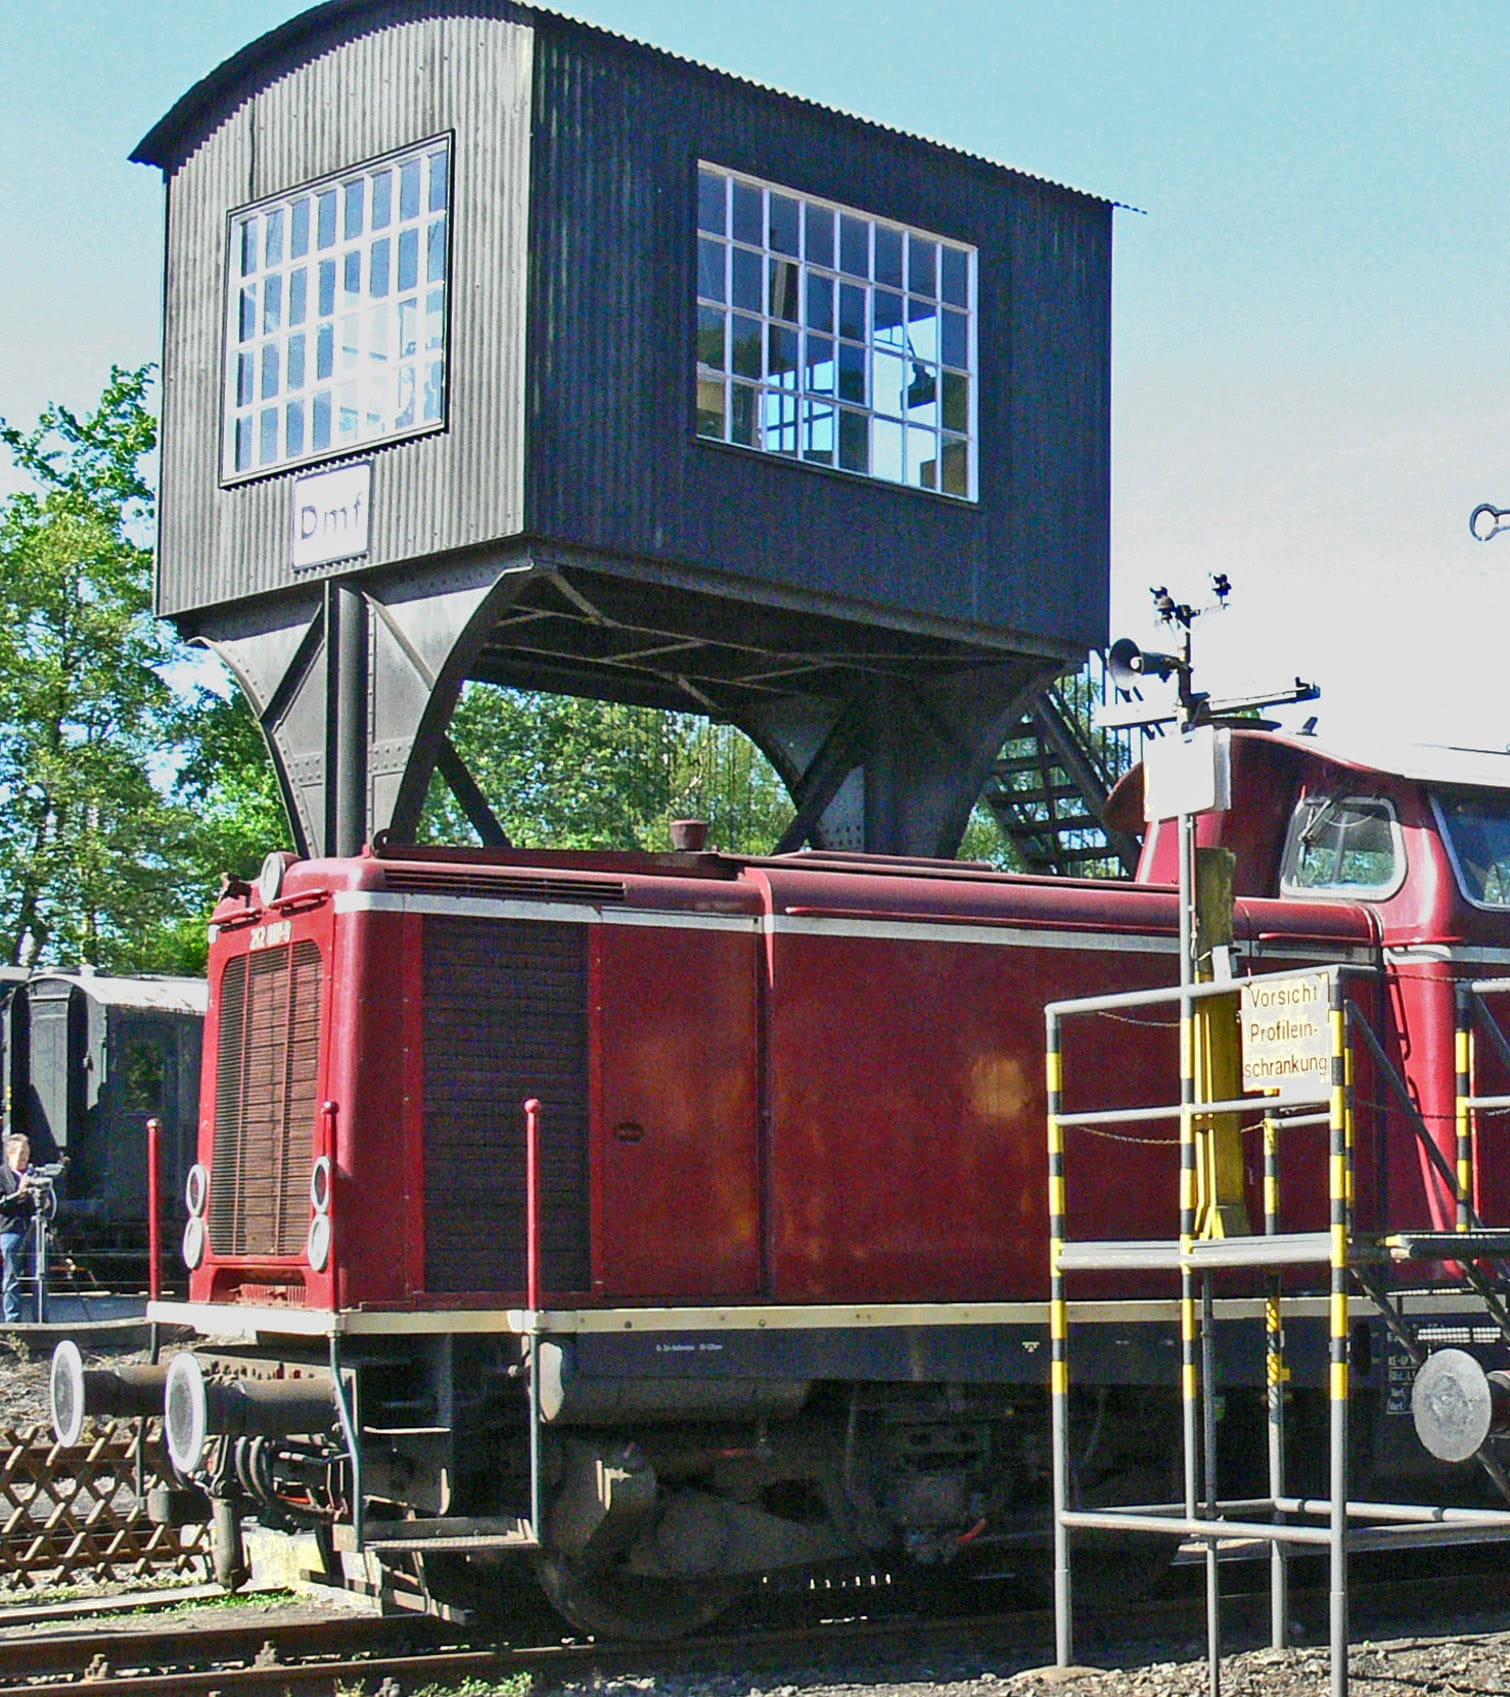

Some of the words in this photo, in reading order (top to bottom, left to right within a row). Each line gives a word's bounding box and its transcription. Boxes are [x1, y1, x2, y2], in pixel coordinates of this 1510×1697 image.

[301, 491, 362, 540] Dmf
[1250, 983, 1318, 1008] Vorsicht
[1250, 1019, 1318, 1043] Profilein-
